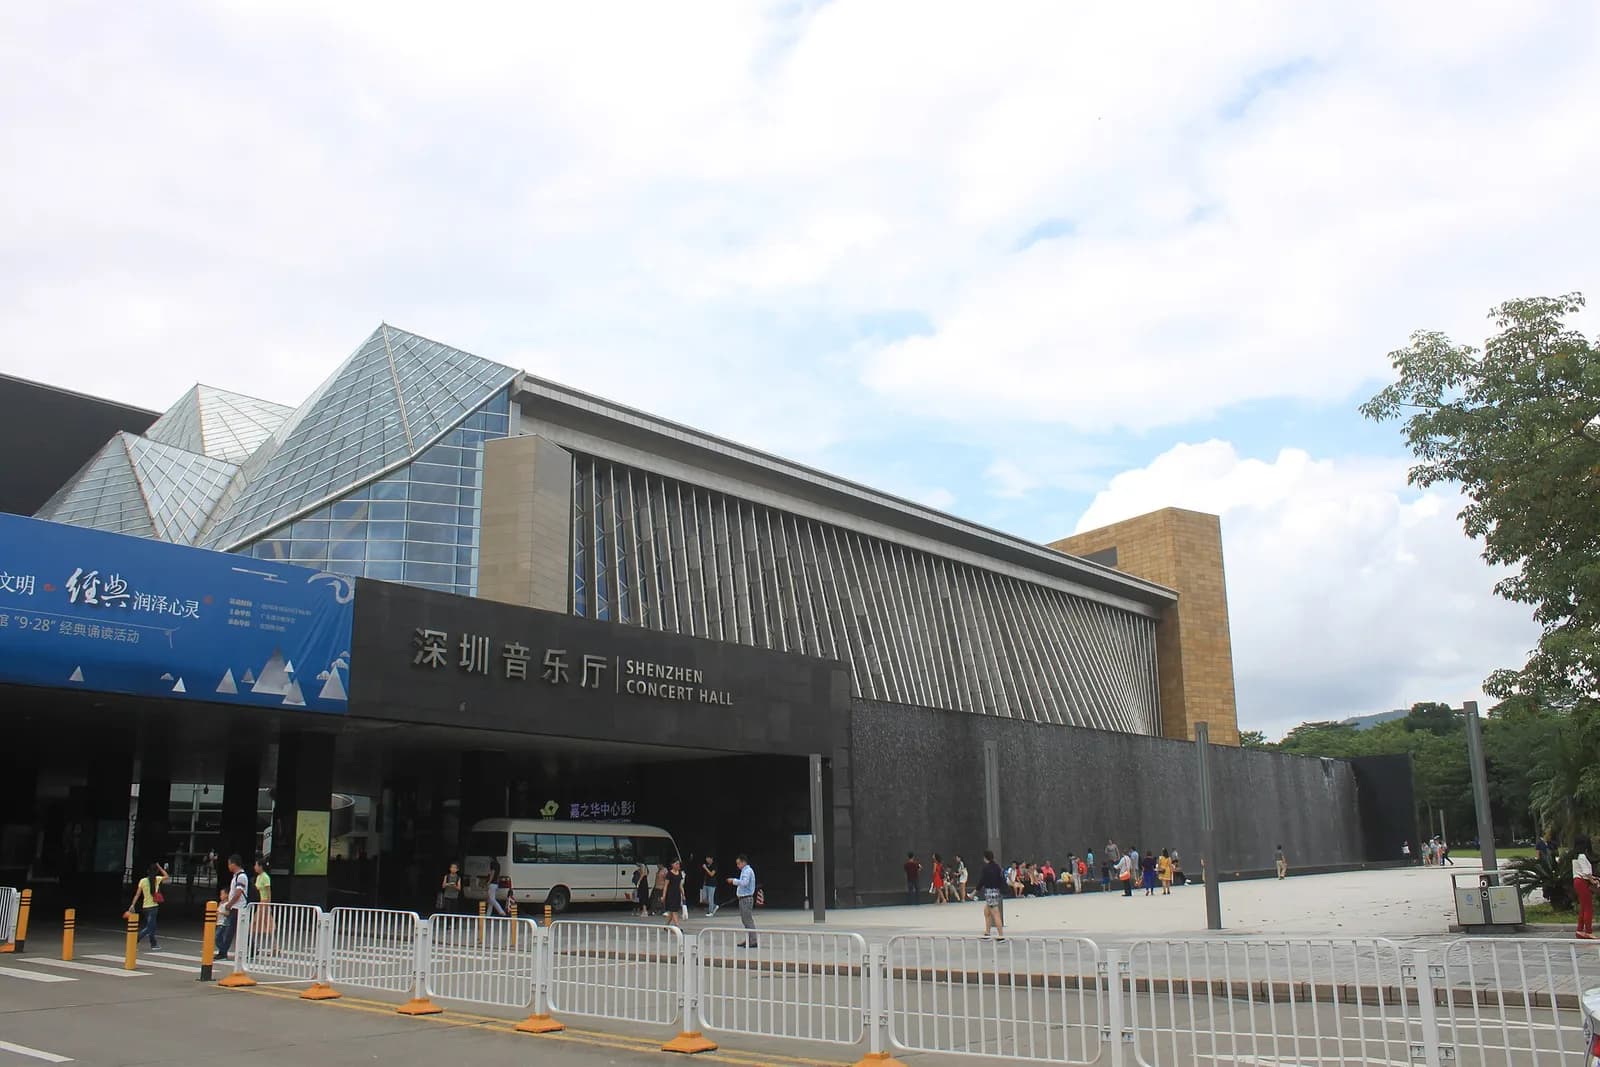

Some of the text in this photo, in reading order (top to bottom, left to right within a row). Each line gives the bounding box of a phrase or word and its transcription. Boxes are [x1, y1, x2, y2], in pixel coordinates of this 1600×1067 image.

[0, 571, 35, 596] 文明
[133, 590, 200, 619] 润泽心灵
[413, 627, 607, 689] 深圳音乐厅
[626, 659, 704, 684] SHENZHEN
[626, 679, 734, 706] CONCERT HALL
